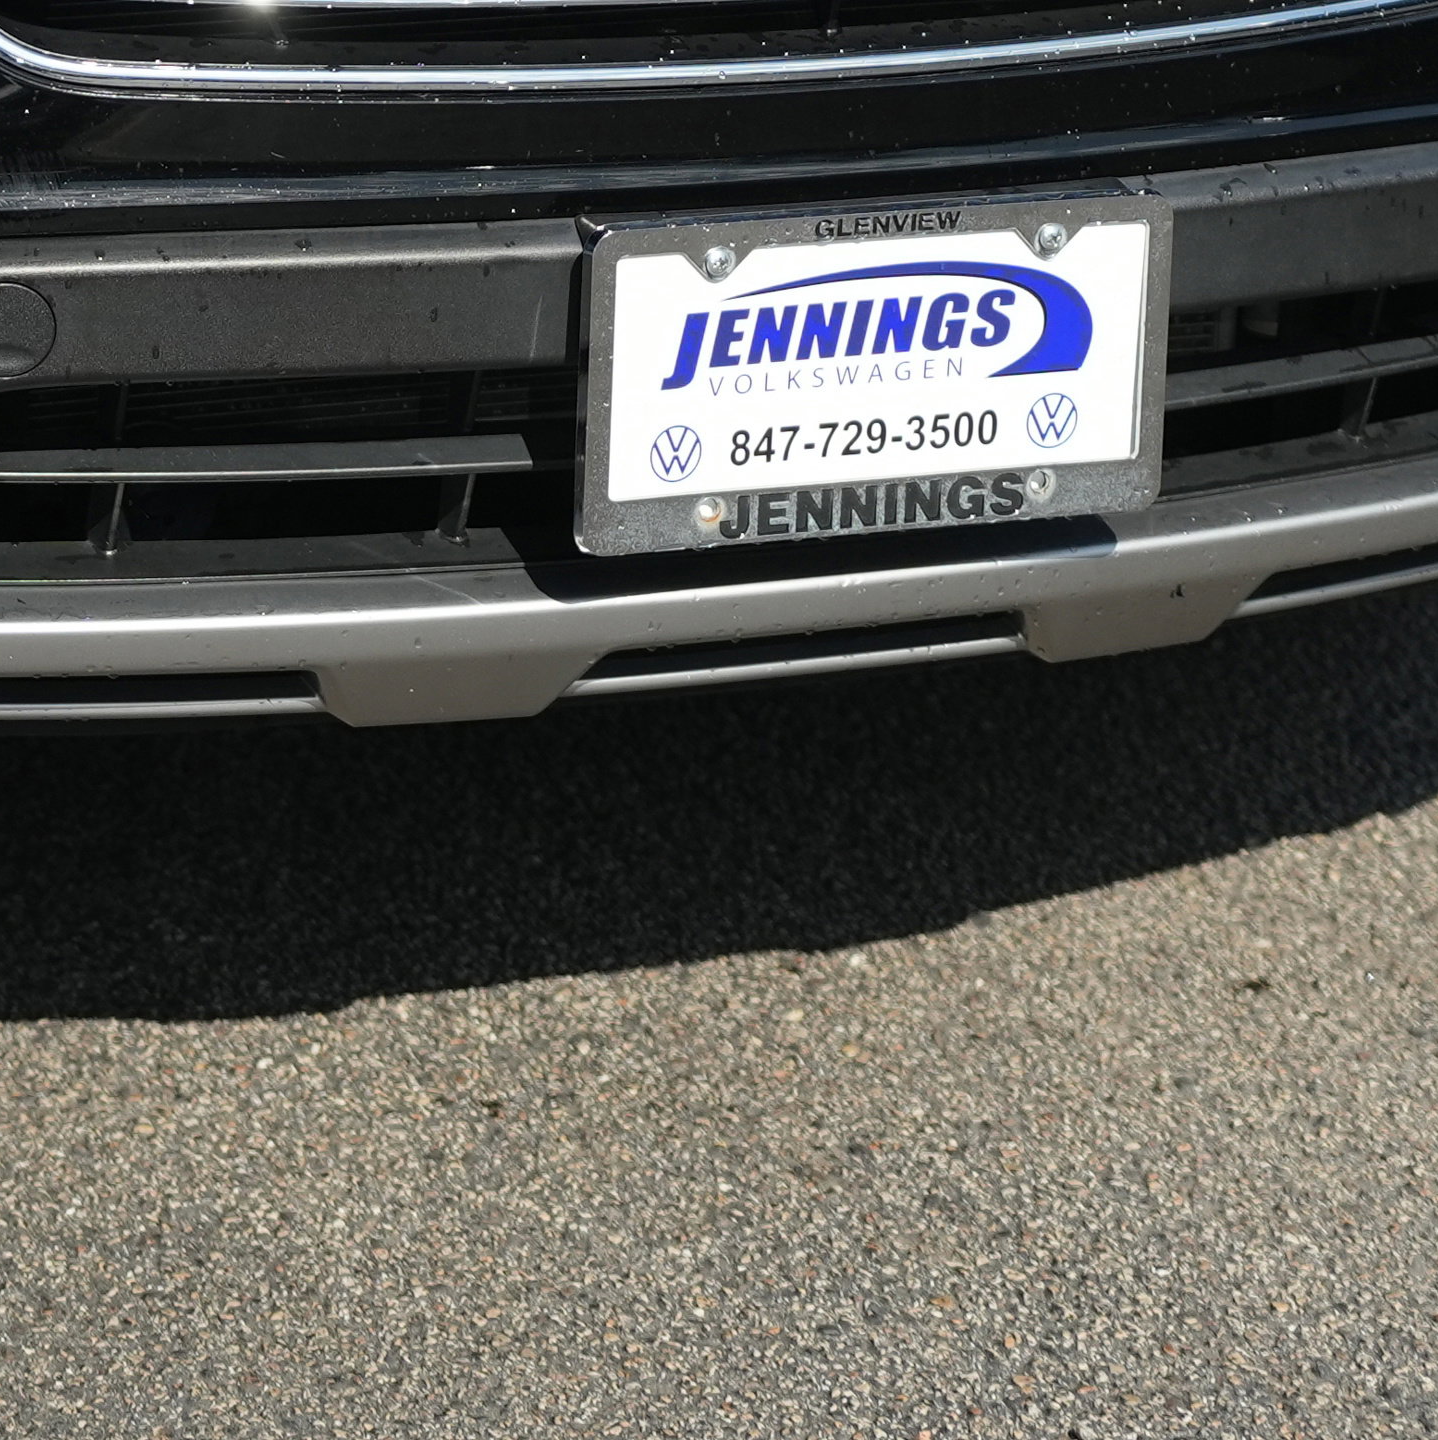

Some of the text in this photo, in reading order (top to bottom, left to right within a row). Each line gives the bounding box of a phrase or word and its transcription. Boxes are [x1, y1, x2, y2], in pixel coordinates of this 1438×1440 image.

[814, 211, 961, 240] GLENVIEW
[660, 289, 1016, 390] JENNINGS
[709, 357, 963, 396] VOLKSWAGEN
[730, 409, 998, 466] 847-729-3500
[720, 472, 1023, 539] JENNINGS
